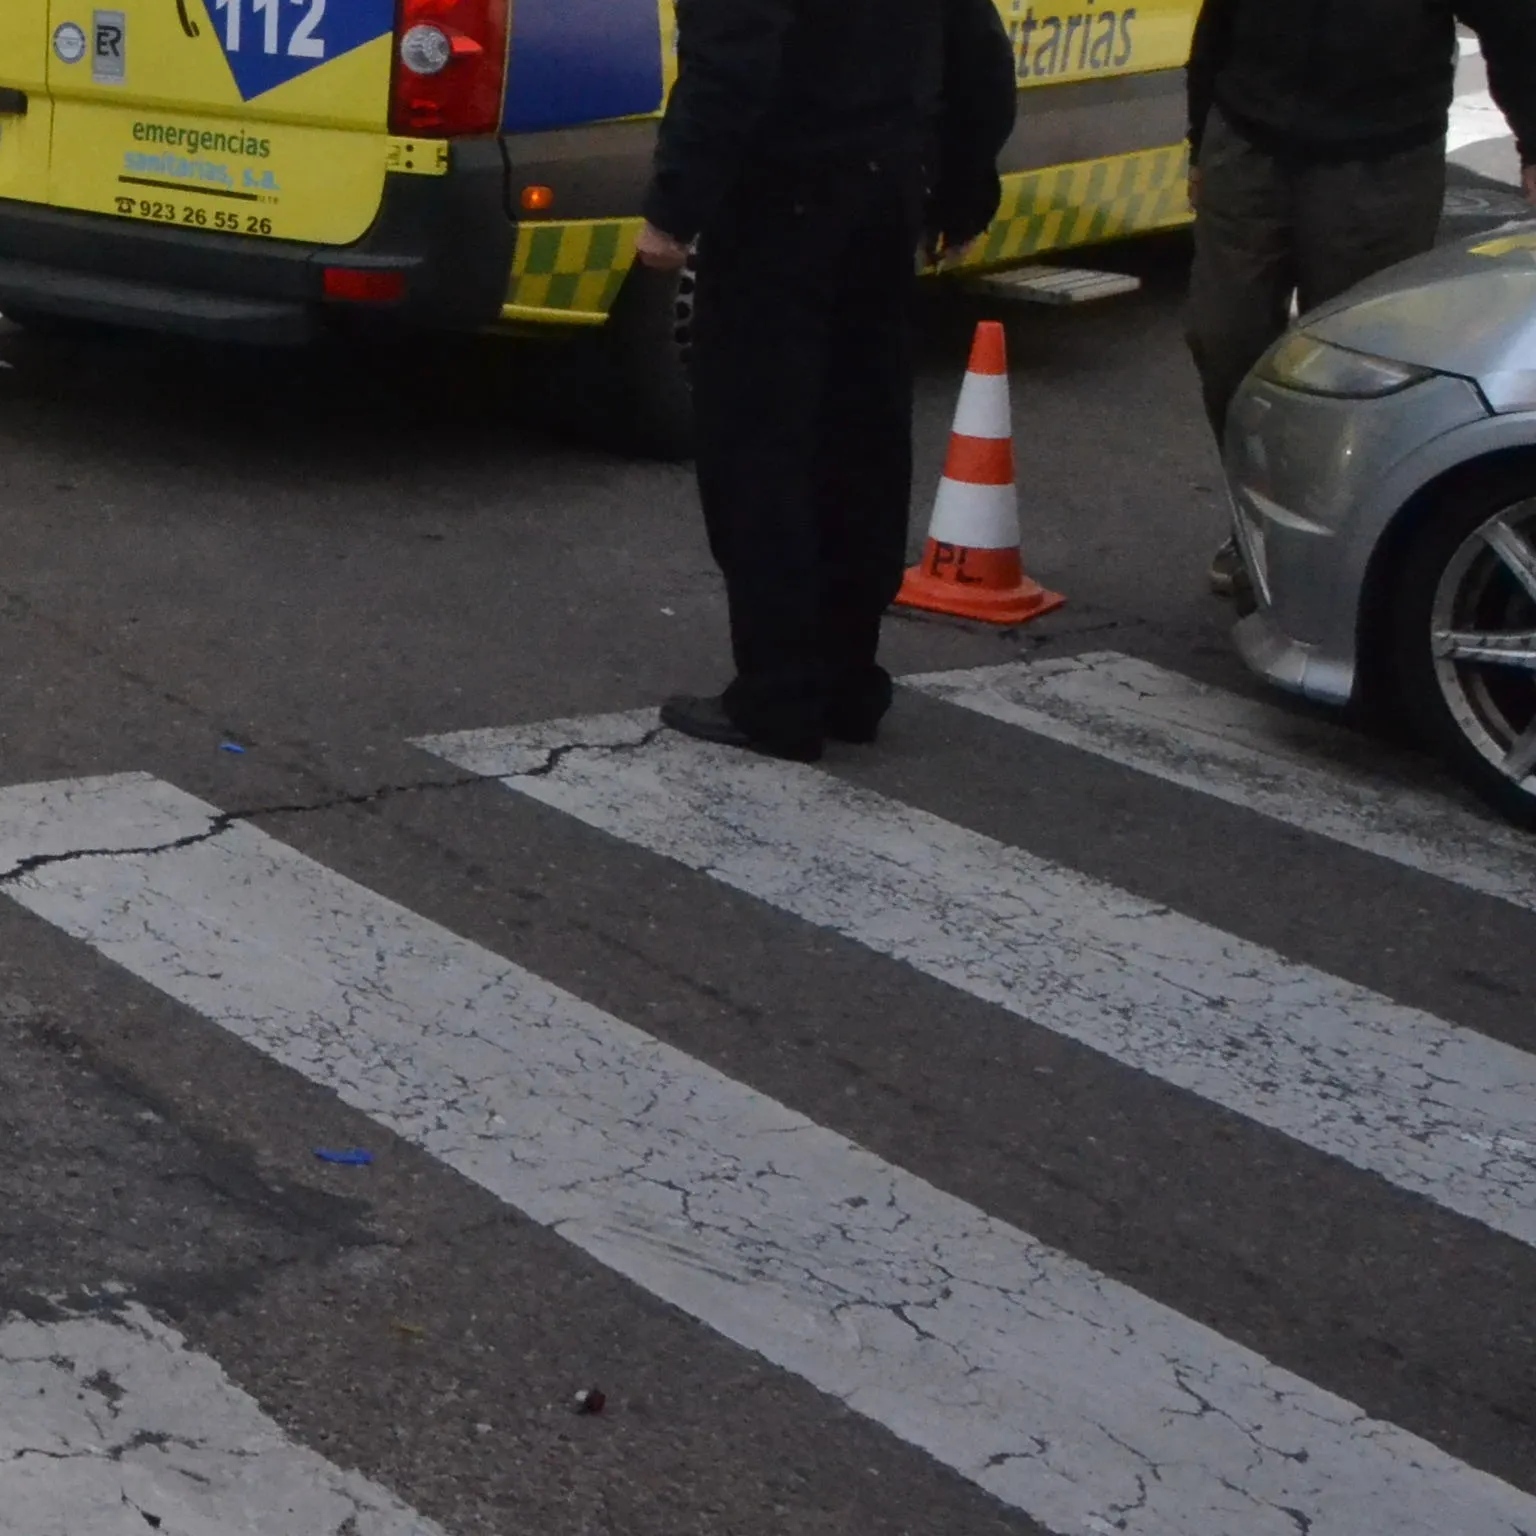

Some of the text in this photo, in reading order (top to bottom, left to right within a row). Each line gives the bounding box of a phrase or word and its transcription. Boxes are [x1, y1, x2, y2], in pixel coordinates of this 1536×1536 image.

[132, 120, 272, 159] emergencias
[139, 199, 273, 236] 923 26 55 26
